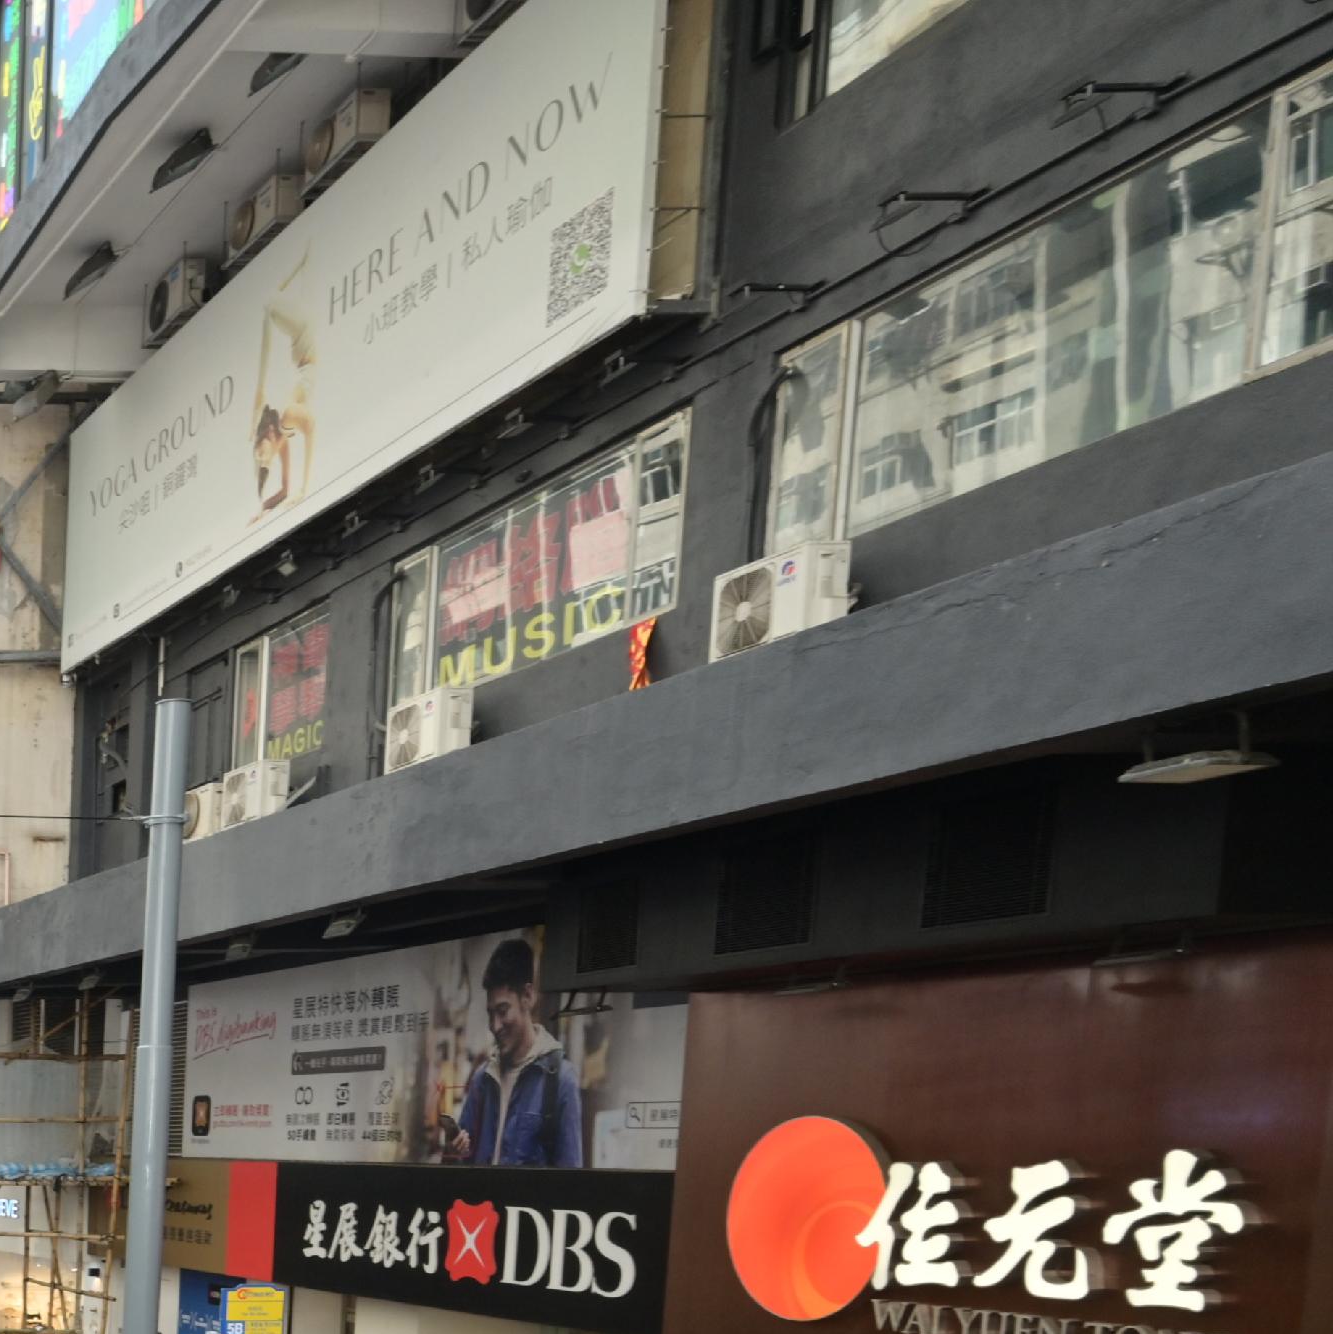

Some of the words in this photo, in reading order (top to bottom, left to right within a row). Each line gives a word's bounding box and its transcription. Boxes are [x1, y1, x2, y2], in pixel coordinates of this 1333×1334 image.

[329, 227, 404, 325] HERE
[415, 161, 490, 257] AND
[505, 51, 613, 181] NOW
[90, 458, 137, 517] YOGA
[144, 374, 234, 473] GROUND
[439, 585, 624, 688] MUSIC
[268, 719, 324, 760] MAGIC
[303, 1200, 444, 1275] 星展銀行
[500, 1205, 637, 1297] DBS
[227, 1322, 243, 1334] 5B
